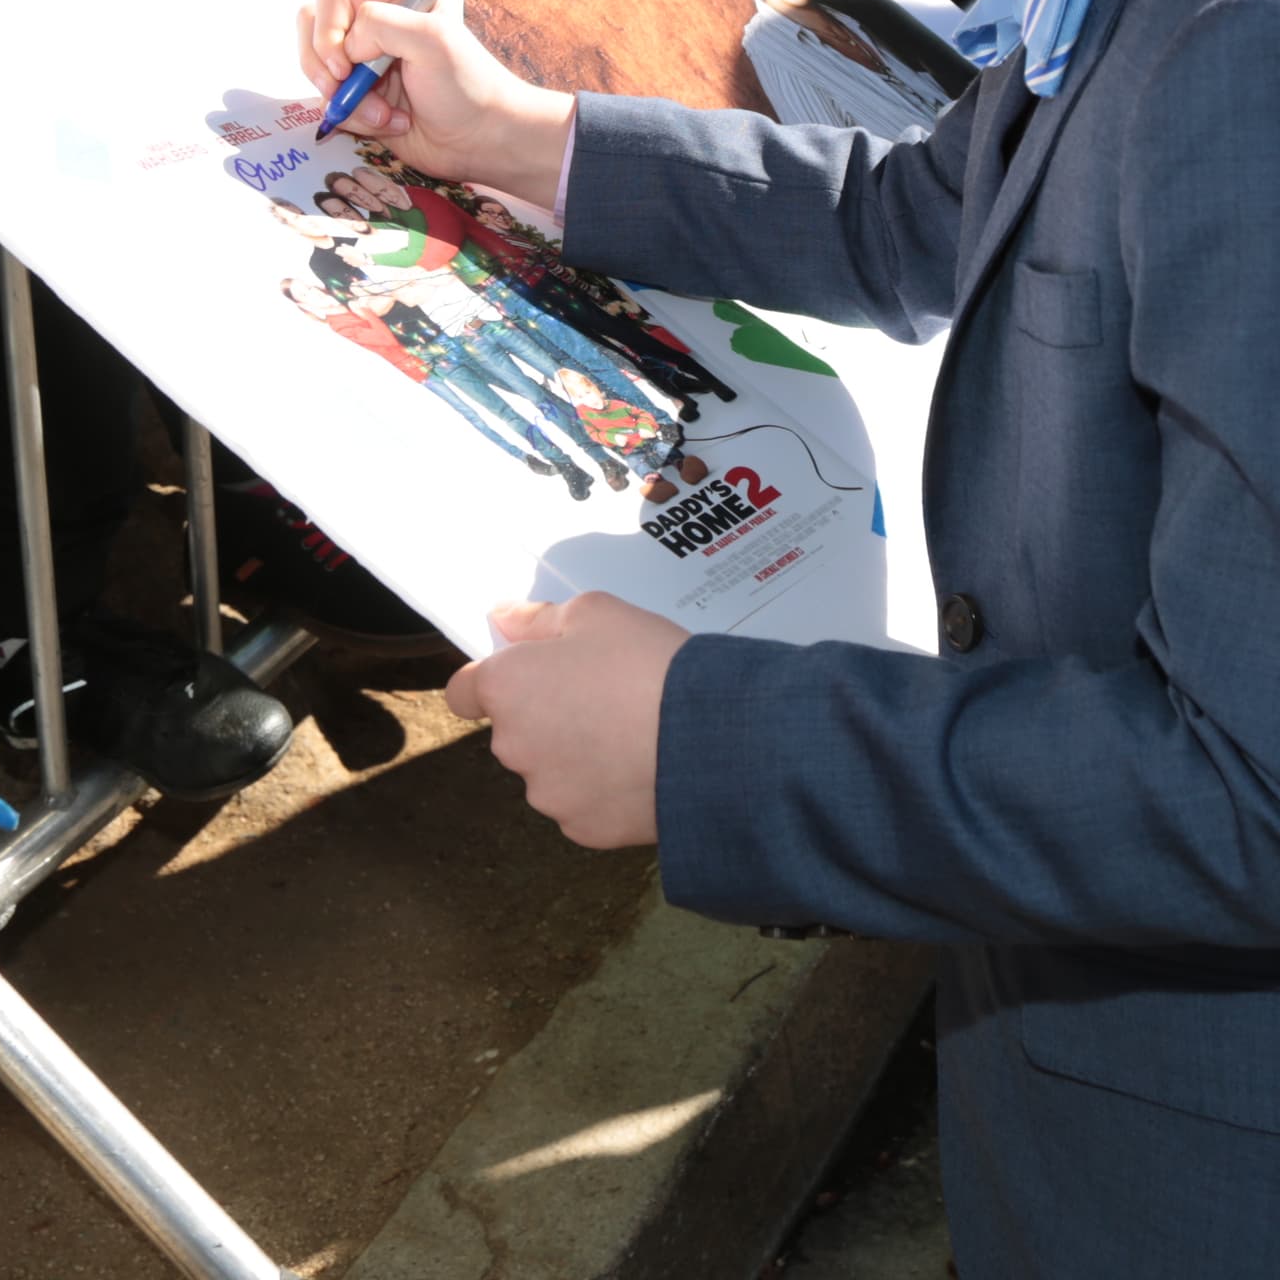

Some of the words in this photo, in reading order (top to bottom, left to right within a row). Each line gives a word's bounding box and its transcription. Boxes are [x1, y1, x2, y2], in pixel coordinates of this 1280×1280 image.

[234, 147, 310, 192] Owen
[641, 479, 732, 539] DADDY'S
[658, 493, 757, 559] HOME
[724, 466, 783, 510] 2
